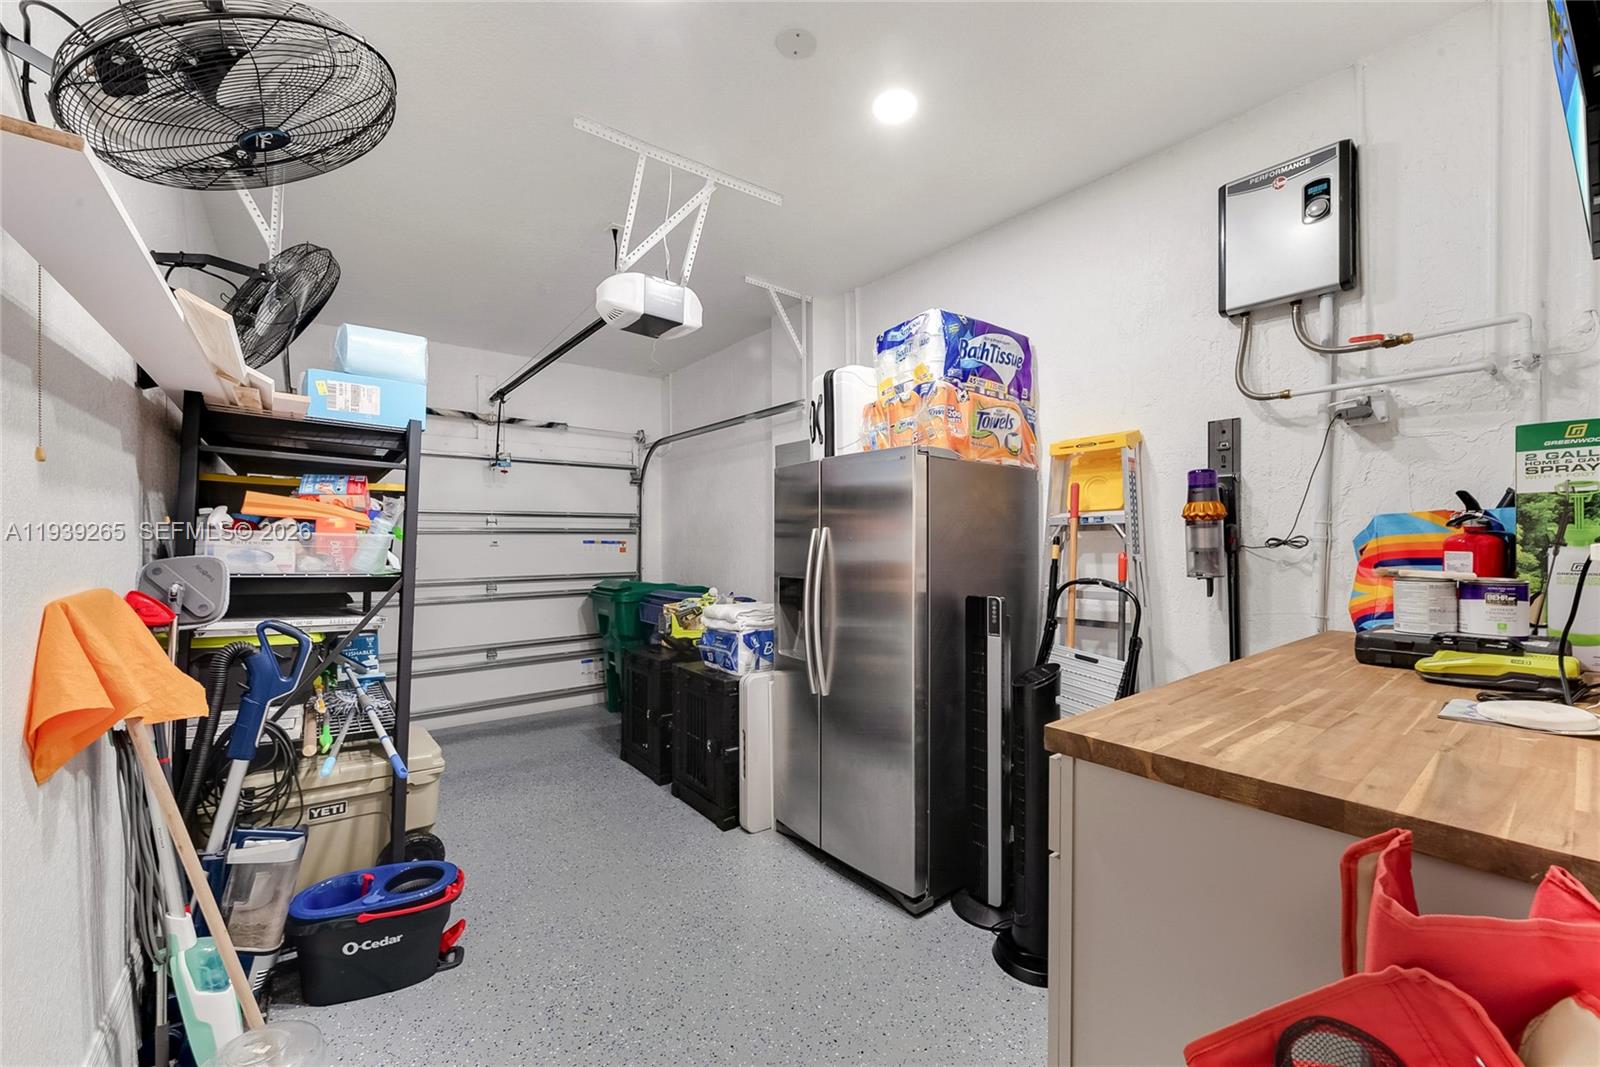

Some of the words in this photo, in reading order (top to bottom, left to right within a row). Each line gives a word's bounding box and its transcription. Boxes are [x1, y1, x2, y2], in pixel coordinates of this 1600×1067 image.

[1248, 157, 1311, 185] PERFORMANCE
[976, 411, 1015, 430] Towels
[1525, 453, 1537, 461] 2
[1525, 463, 1600, 475] SPRAY
[310, 802, 345, 818] YETI
[342, 933, 403, 955] O-Cedar
